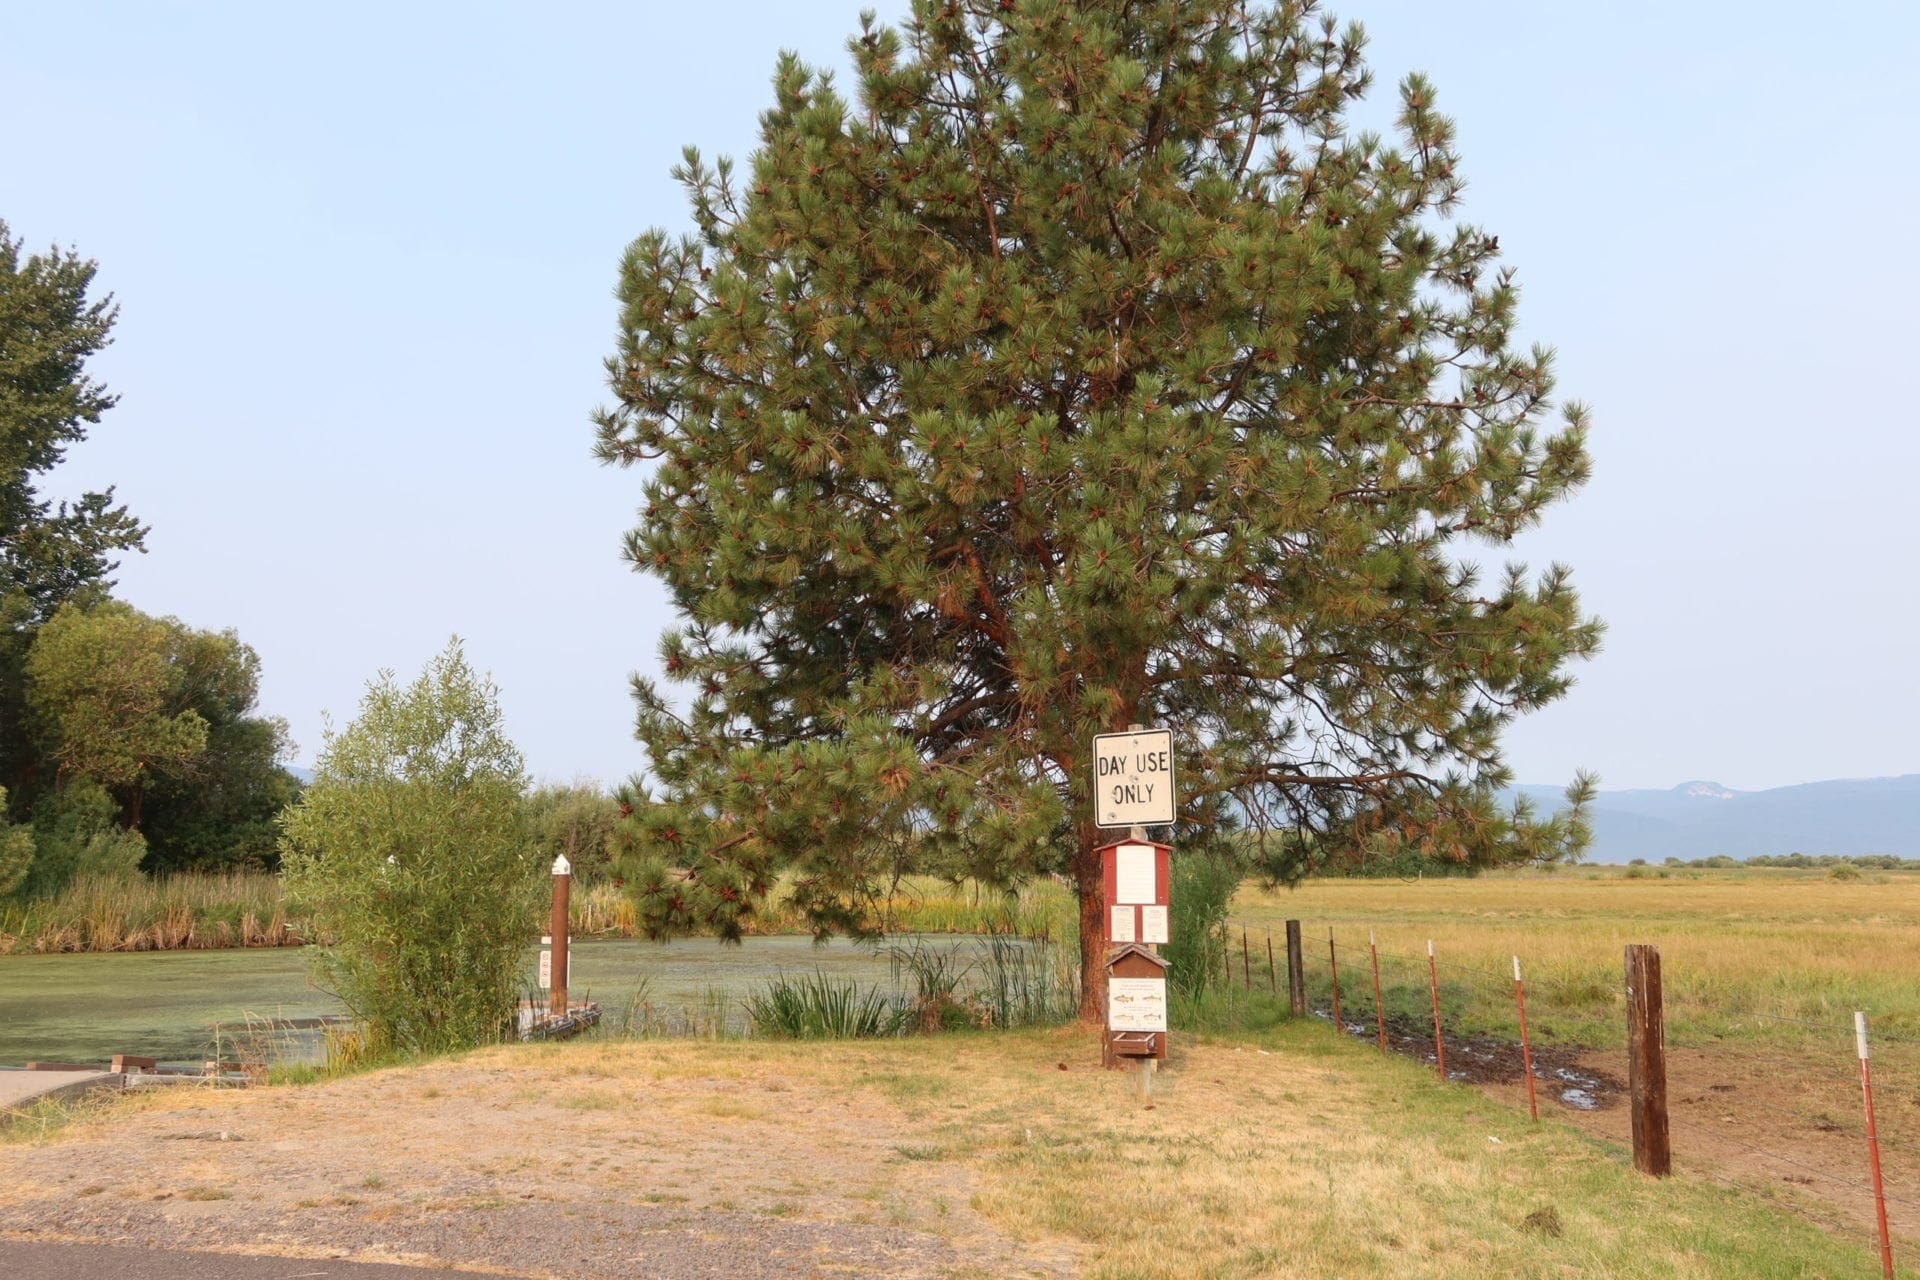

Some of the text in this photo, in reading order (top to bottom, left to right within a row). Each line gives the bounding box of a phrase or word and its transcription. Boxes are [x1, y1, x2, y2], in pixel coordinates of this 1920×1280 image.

[1099, 752, 1169, 776] DAY USE
[1113, 784, 1154, 805] ONLY
